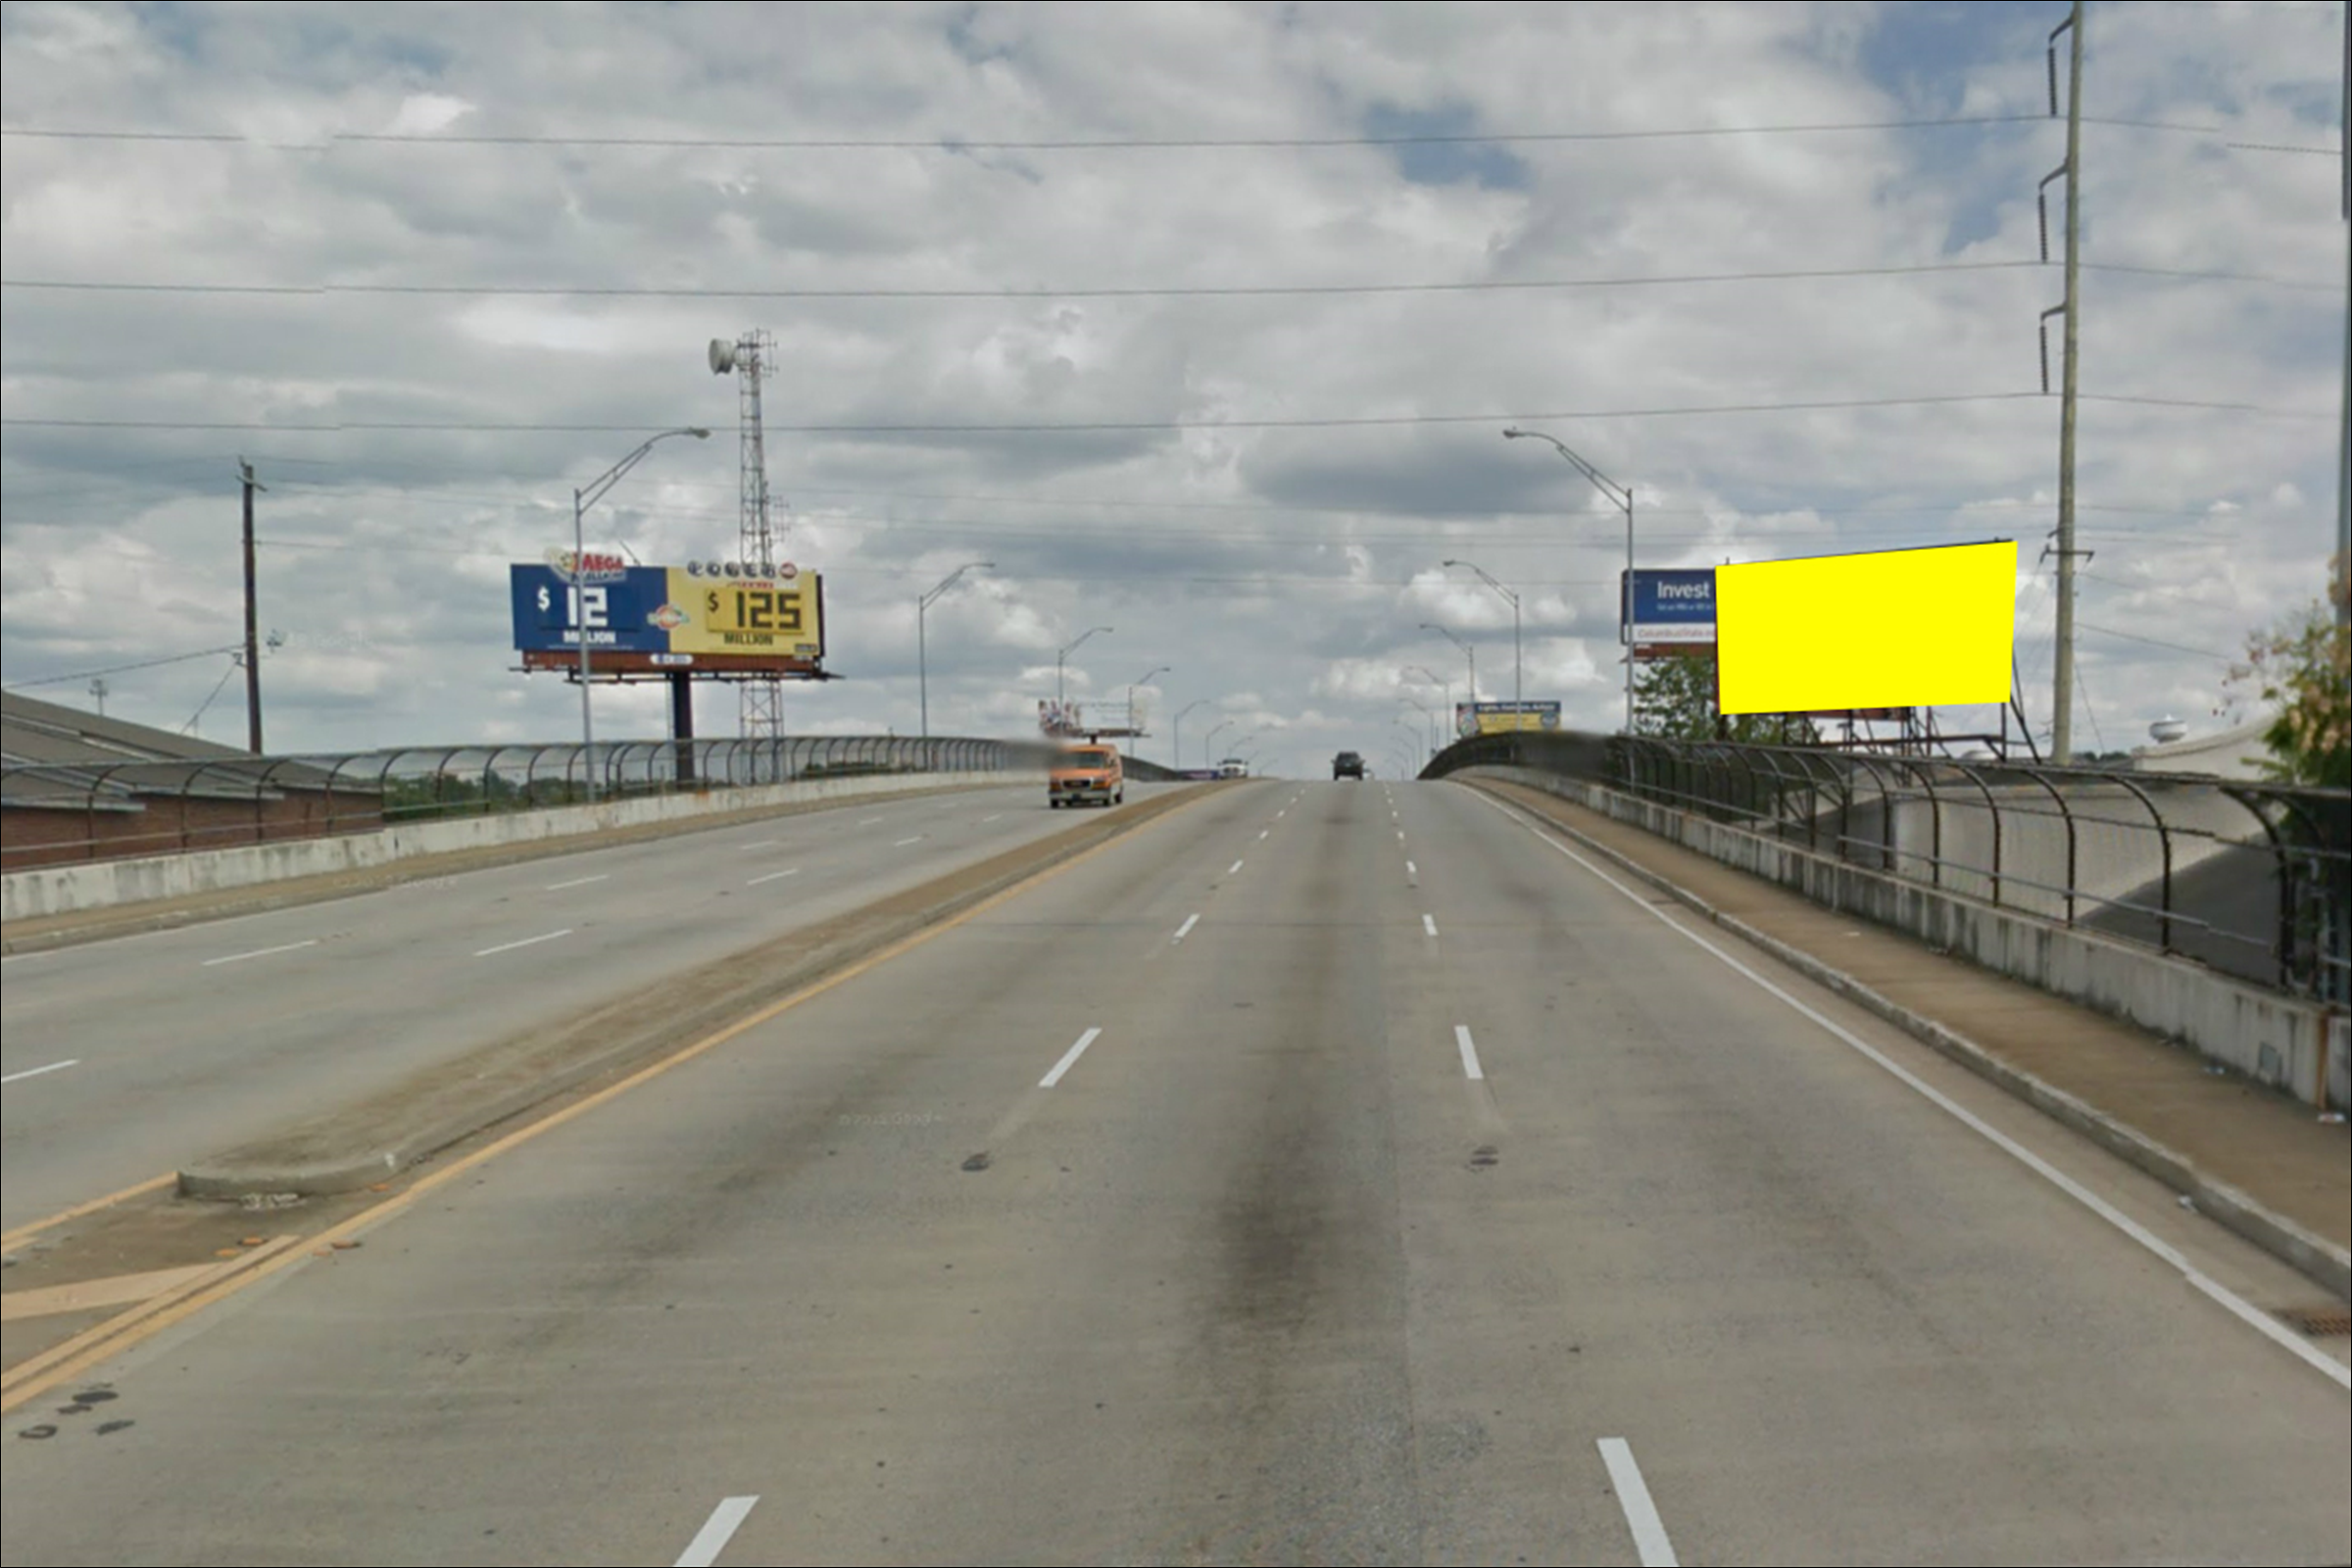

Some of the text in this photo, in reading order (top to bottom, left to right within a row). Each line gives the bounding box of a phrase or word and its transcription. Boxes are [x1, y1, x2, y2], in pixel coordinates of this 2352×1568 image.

[1657, 580, 1711, 599] Invest
[537, 586, 551, 612] $
[567, 587, 608, 627] 12
[708, 591, 803, 630] $ 125
[563, 630, 616, 644] MILION
